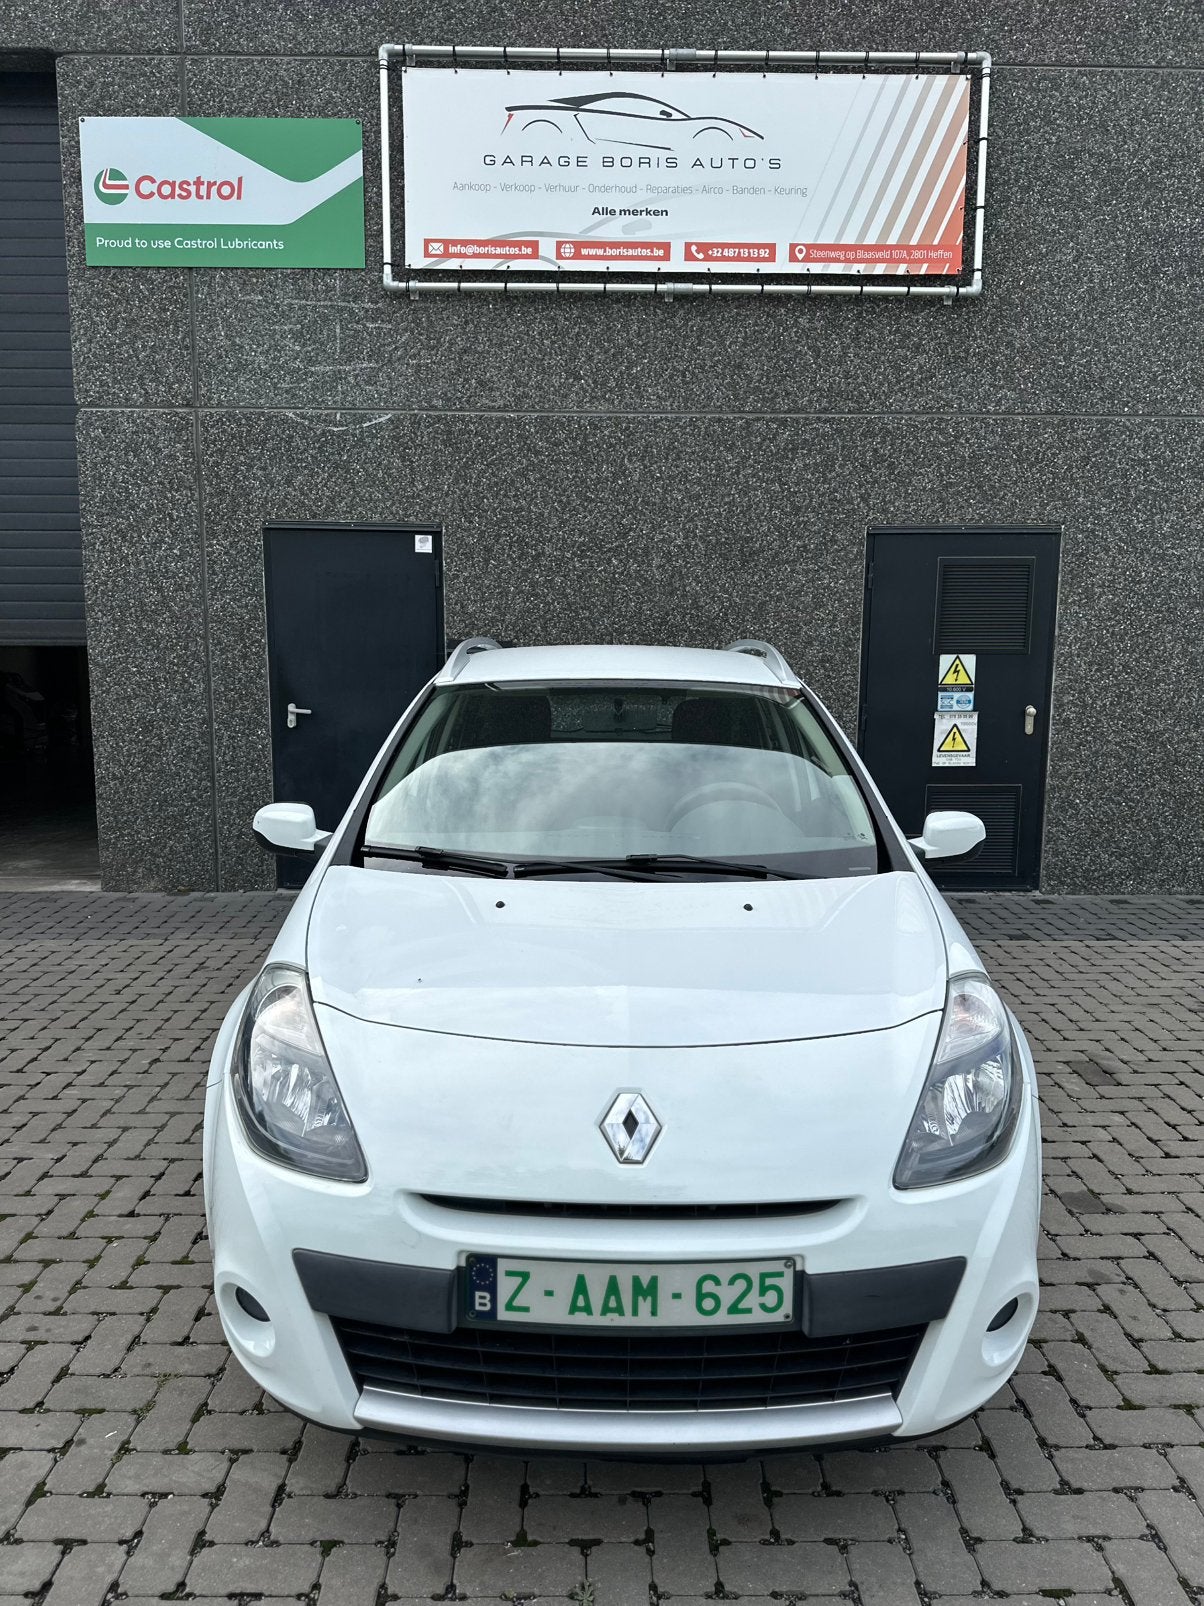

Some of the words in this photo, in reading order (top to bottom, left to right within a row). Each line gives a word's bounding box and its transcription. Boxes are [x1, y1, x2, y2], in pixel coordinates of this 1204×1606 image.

[483, 154, 588, 168] GARAGE
[602, 156, 678, 169] BORIS
[691, 157, 782, 170] AUTO'S
[134, 175, 244, 201] Castrol
[452, 181, 492, 193] Aankoop
[500, 182, 536, 193] Verkoop
[544, 183, 580, 193] Verhuur
[588, 183, 637, 193] Onderhoud
[646, 184, 693, 195] Reparaties
[701, 185, 724, 195] Airco
[732, 185, 766, 195] Banden
[774, 185, 808, 197] Keuring
[592, 206, 617, 216] Alle
[619, 207, 669, 217] merken
[96, 237, 132, 249] Proud
[135, 238, 148, 248] to
[150, 239, 172, 249] use
[174, 238, 218, 249] Castrol
[220, 238, 285, 250] Lubricants
[448, 244, 533, 256] info@borisautos.be
[581, 246, 664, 257] www.borisautos.be
[707, 248, 722, 257] +32
[723, 248, 739, 257] 487
[739, 249, 749, 257] 13
[750, 249, 758, 257] 13
[759, 249, 769, 257] 92
[809, 249, 845, 260] Steenweg
[846, 251, 856, 261] op
[857, 249, 890, 259] Blaasveld
[891, 250, 910, 260] 107A,
[910, 250, 927, 259] 2801
[928, 249, 953, 259] Heffen
[474, 1292, 491, 1311] B
